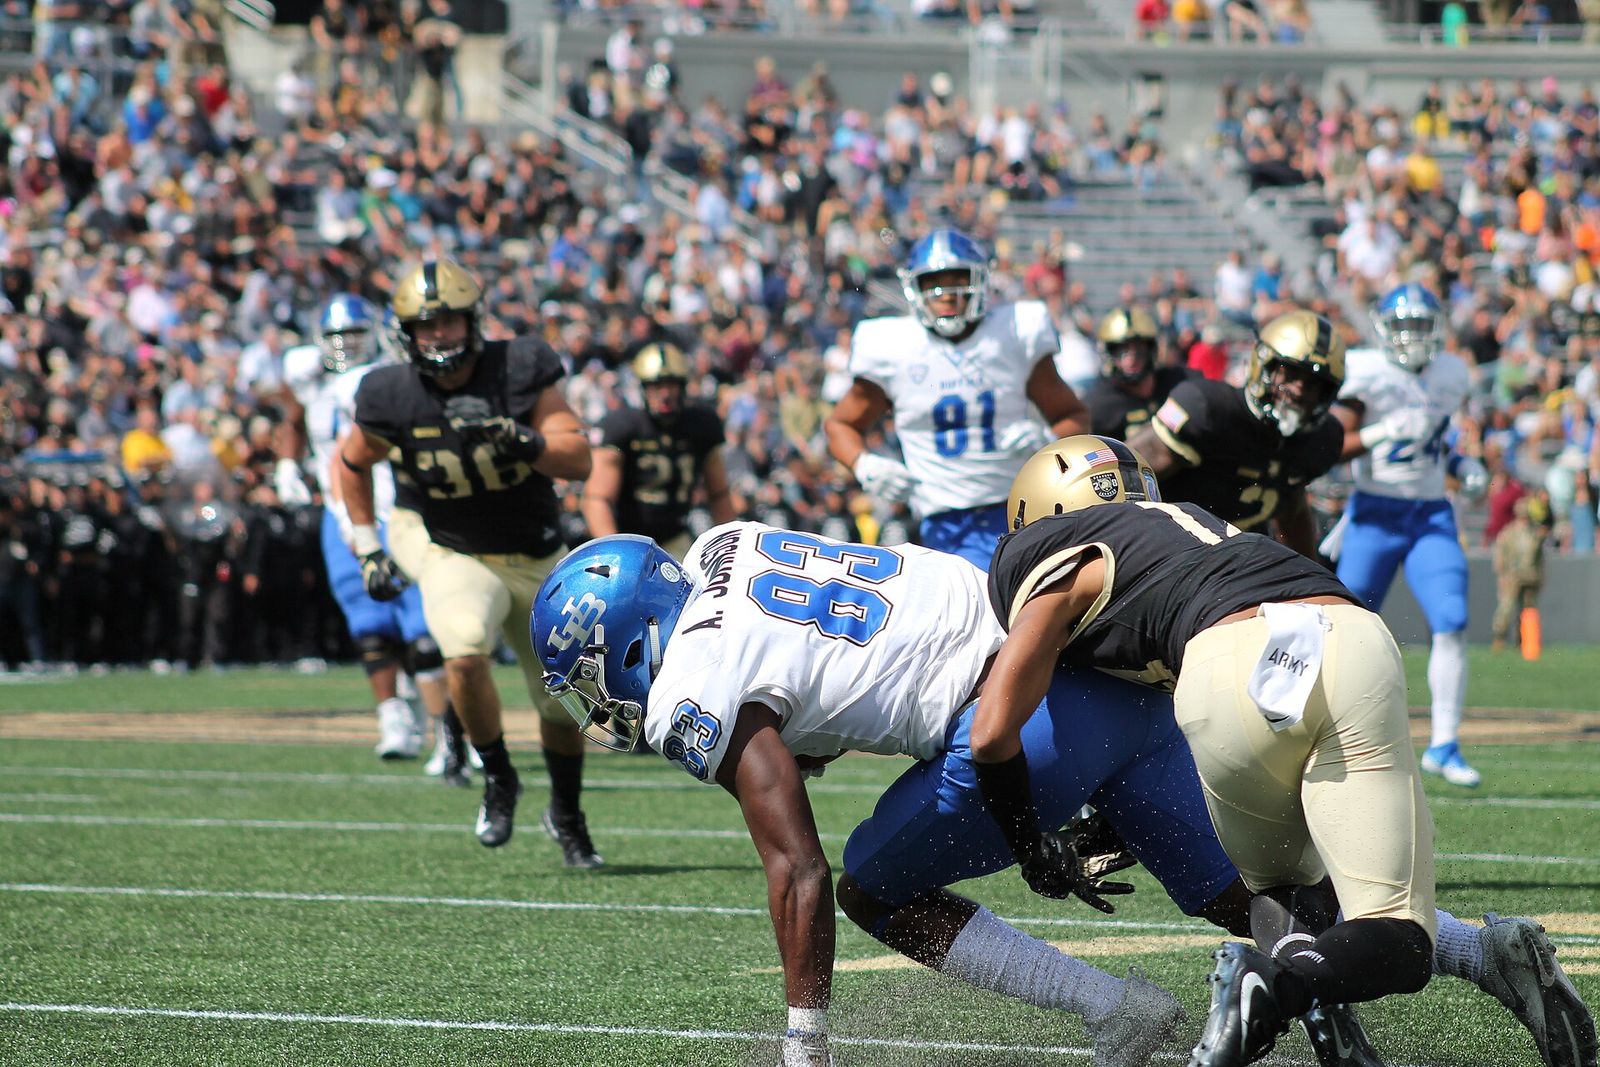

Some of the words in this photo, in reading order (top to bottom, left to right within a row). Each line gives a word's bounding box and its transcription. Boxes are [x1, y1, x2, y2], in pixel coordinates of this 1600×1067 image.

[932, 389, 996, 458] 81
[634, 453, 695, 504] 21
[746, 529, 904, 647] 83
[547, 592, 607, 651] UB
[682, 610, 723, 635] A.
[1268, 648, 1309, 677] ARMY
[662, 697, 722, 781] 83
